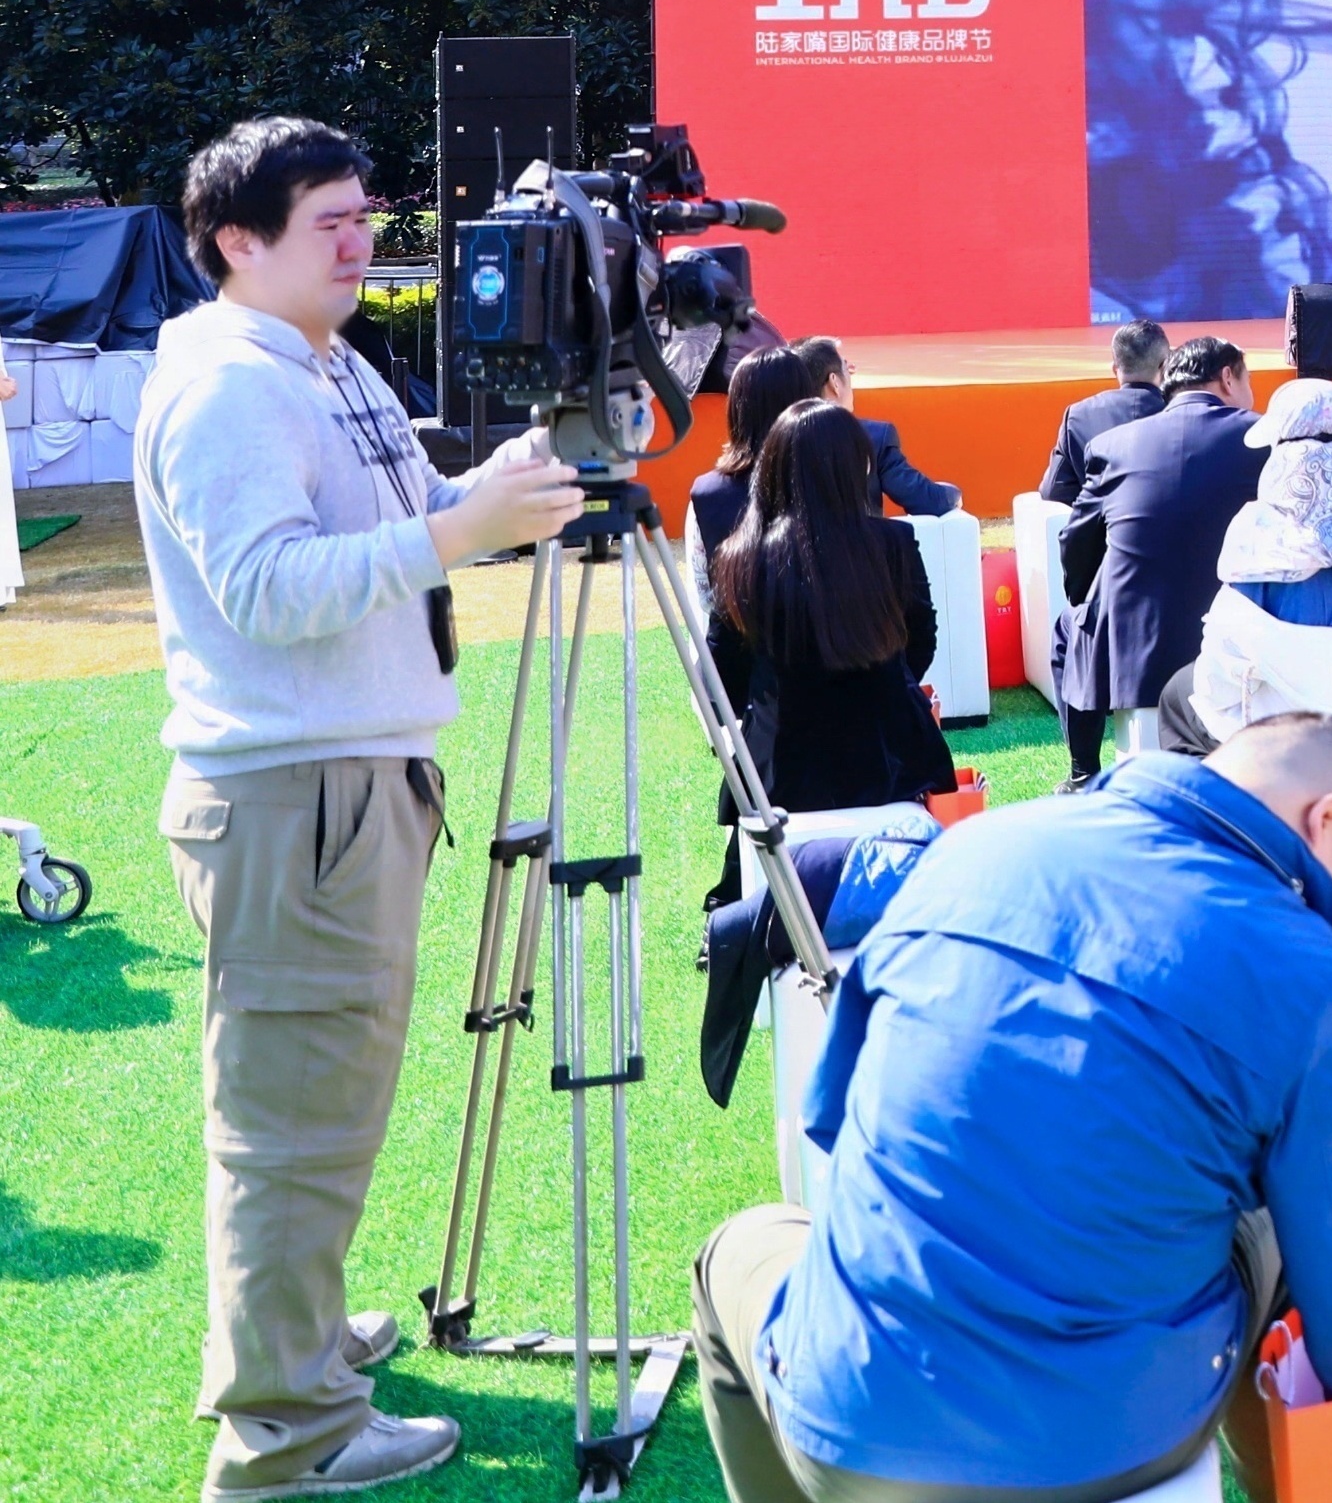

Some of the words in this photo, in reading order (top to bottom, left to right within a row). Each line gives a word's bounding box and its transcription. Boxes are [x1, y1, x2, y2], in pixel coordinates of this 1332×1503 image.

[755, 27, 993, 53] 陆家嘴国际健康品牌节
[755, 56, 845, 66] INTERNATIONAL
[849, 55, 891, 65] HEALTH
